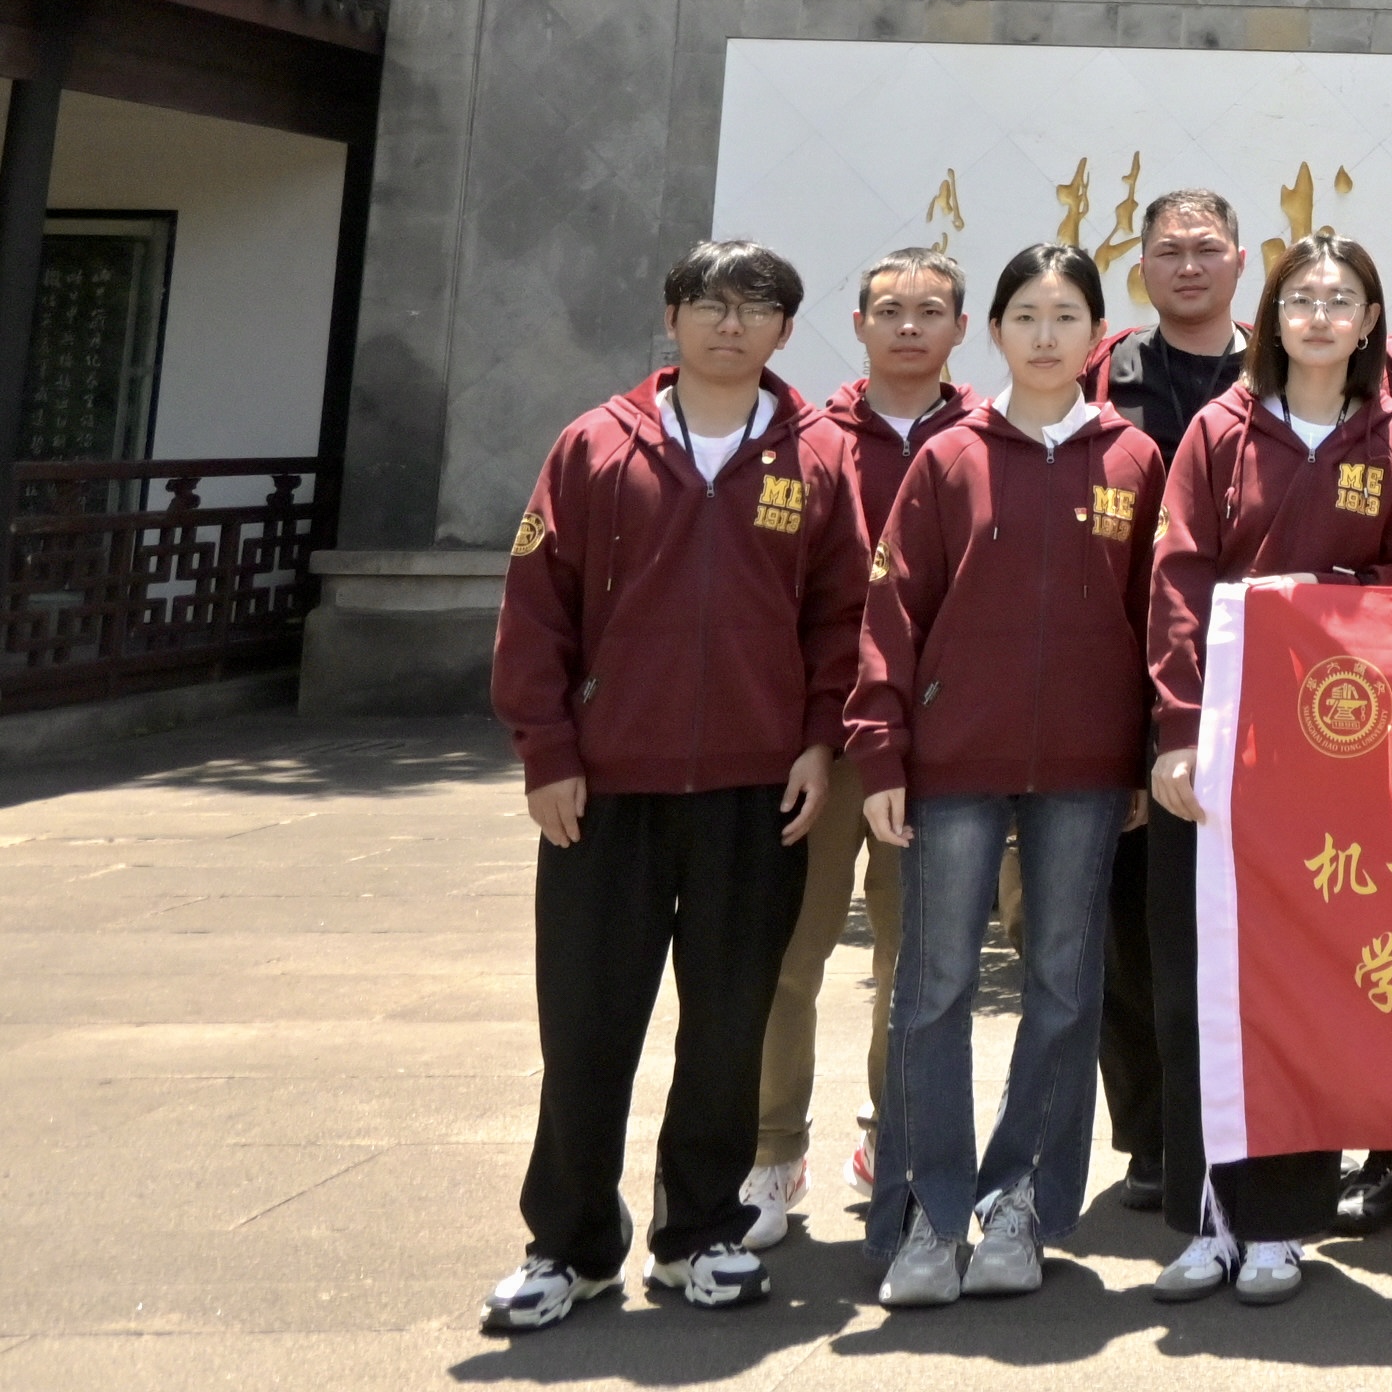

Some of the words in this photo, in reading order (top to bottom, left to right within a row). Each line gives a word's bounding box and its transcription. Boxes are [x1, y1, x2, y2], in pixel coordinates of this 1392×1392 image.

[759, 474, 810, 511] ME
[1338, 463, 1384, 496] ME
[1093, 485, 1135, 520] ME
[754, 506, 800, 534] 1913
